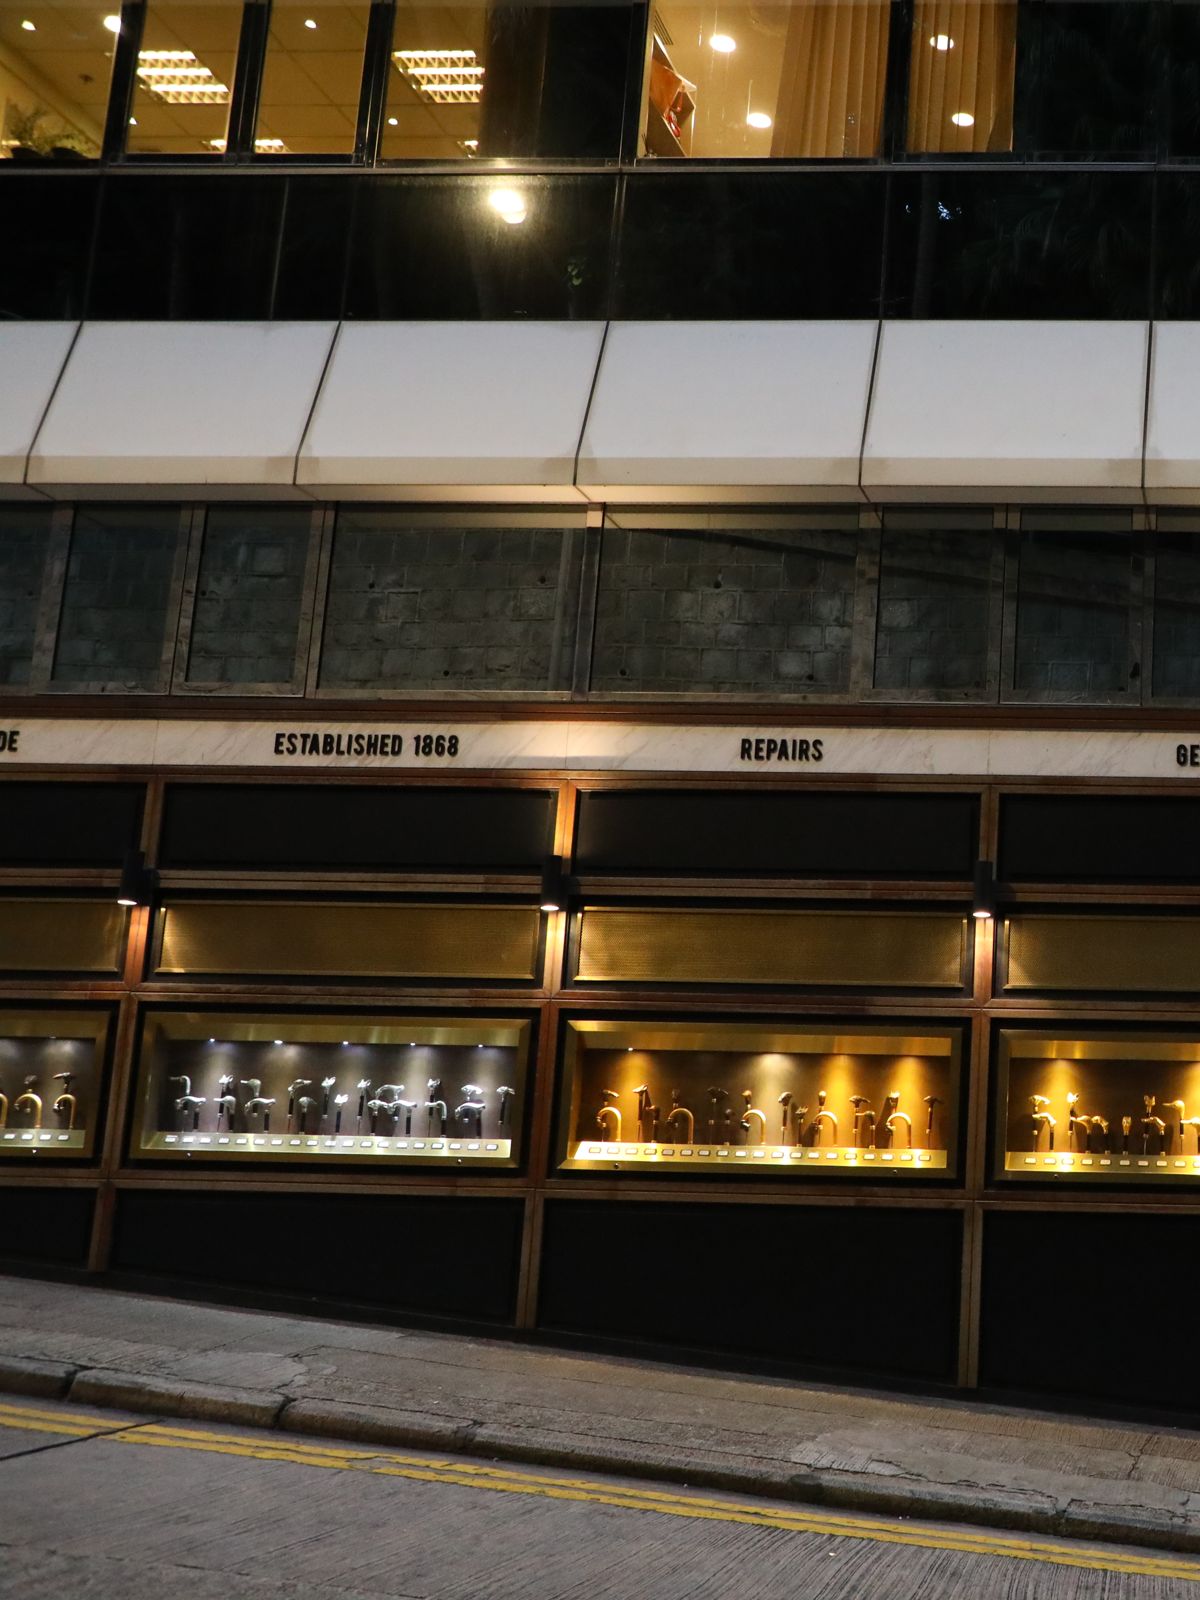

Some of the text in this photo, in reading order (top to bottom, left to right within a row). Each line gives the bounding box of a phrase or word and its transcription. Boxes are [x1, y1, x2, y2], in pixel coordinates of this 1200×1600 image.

[274, 733, 459, 757] ESTABLISHED 1868
[740, 738, 824, 761] REPAIRS
